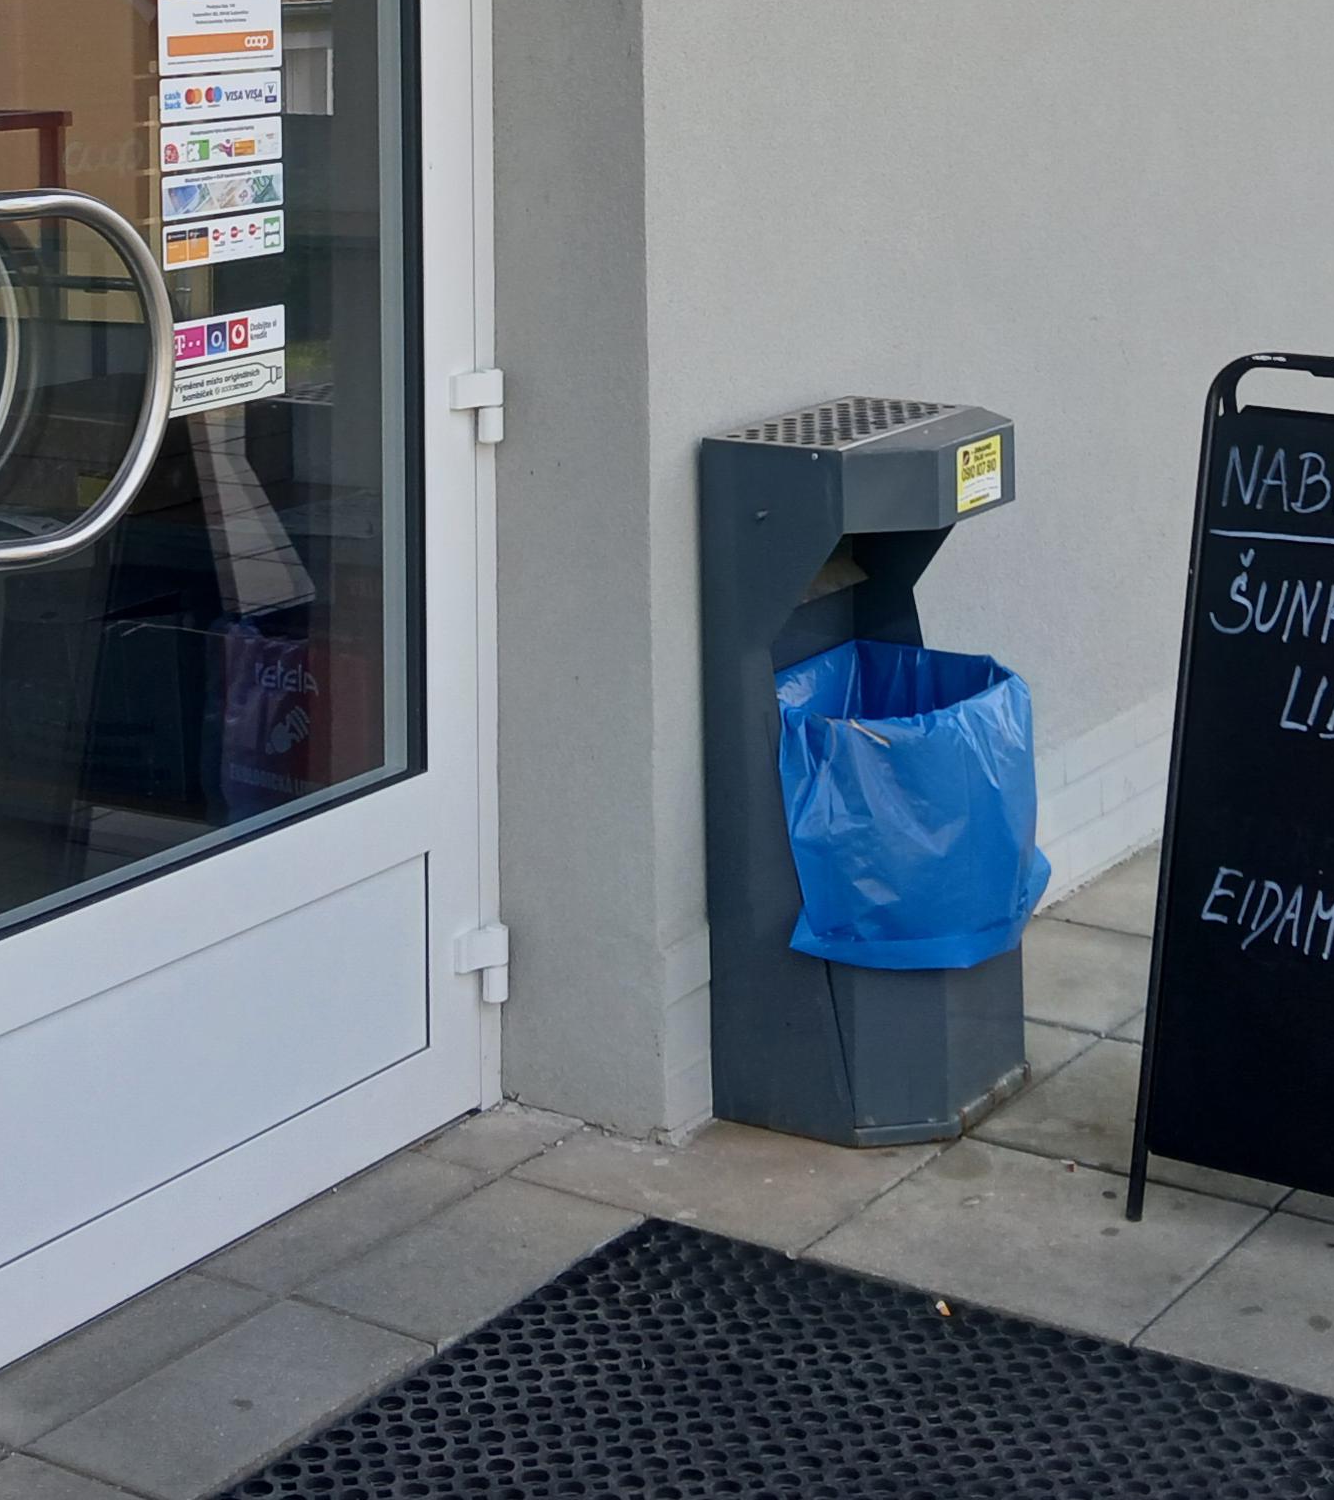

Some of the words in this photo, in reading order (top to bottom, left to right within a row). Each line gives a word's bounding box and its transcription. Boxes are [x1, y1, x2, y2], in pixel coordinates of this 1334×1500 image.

[244, 35, 268, 49] coop
[164, 91, 181, 100] cash
[224, 90, 244, 101] VISA
[244, 89, 263, 100] VISA
[164, 101, 181, 110] back
